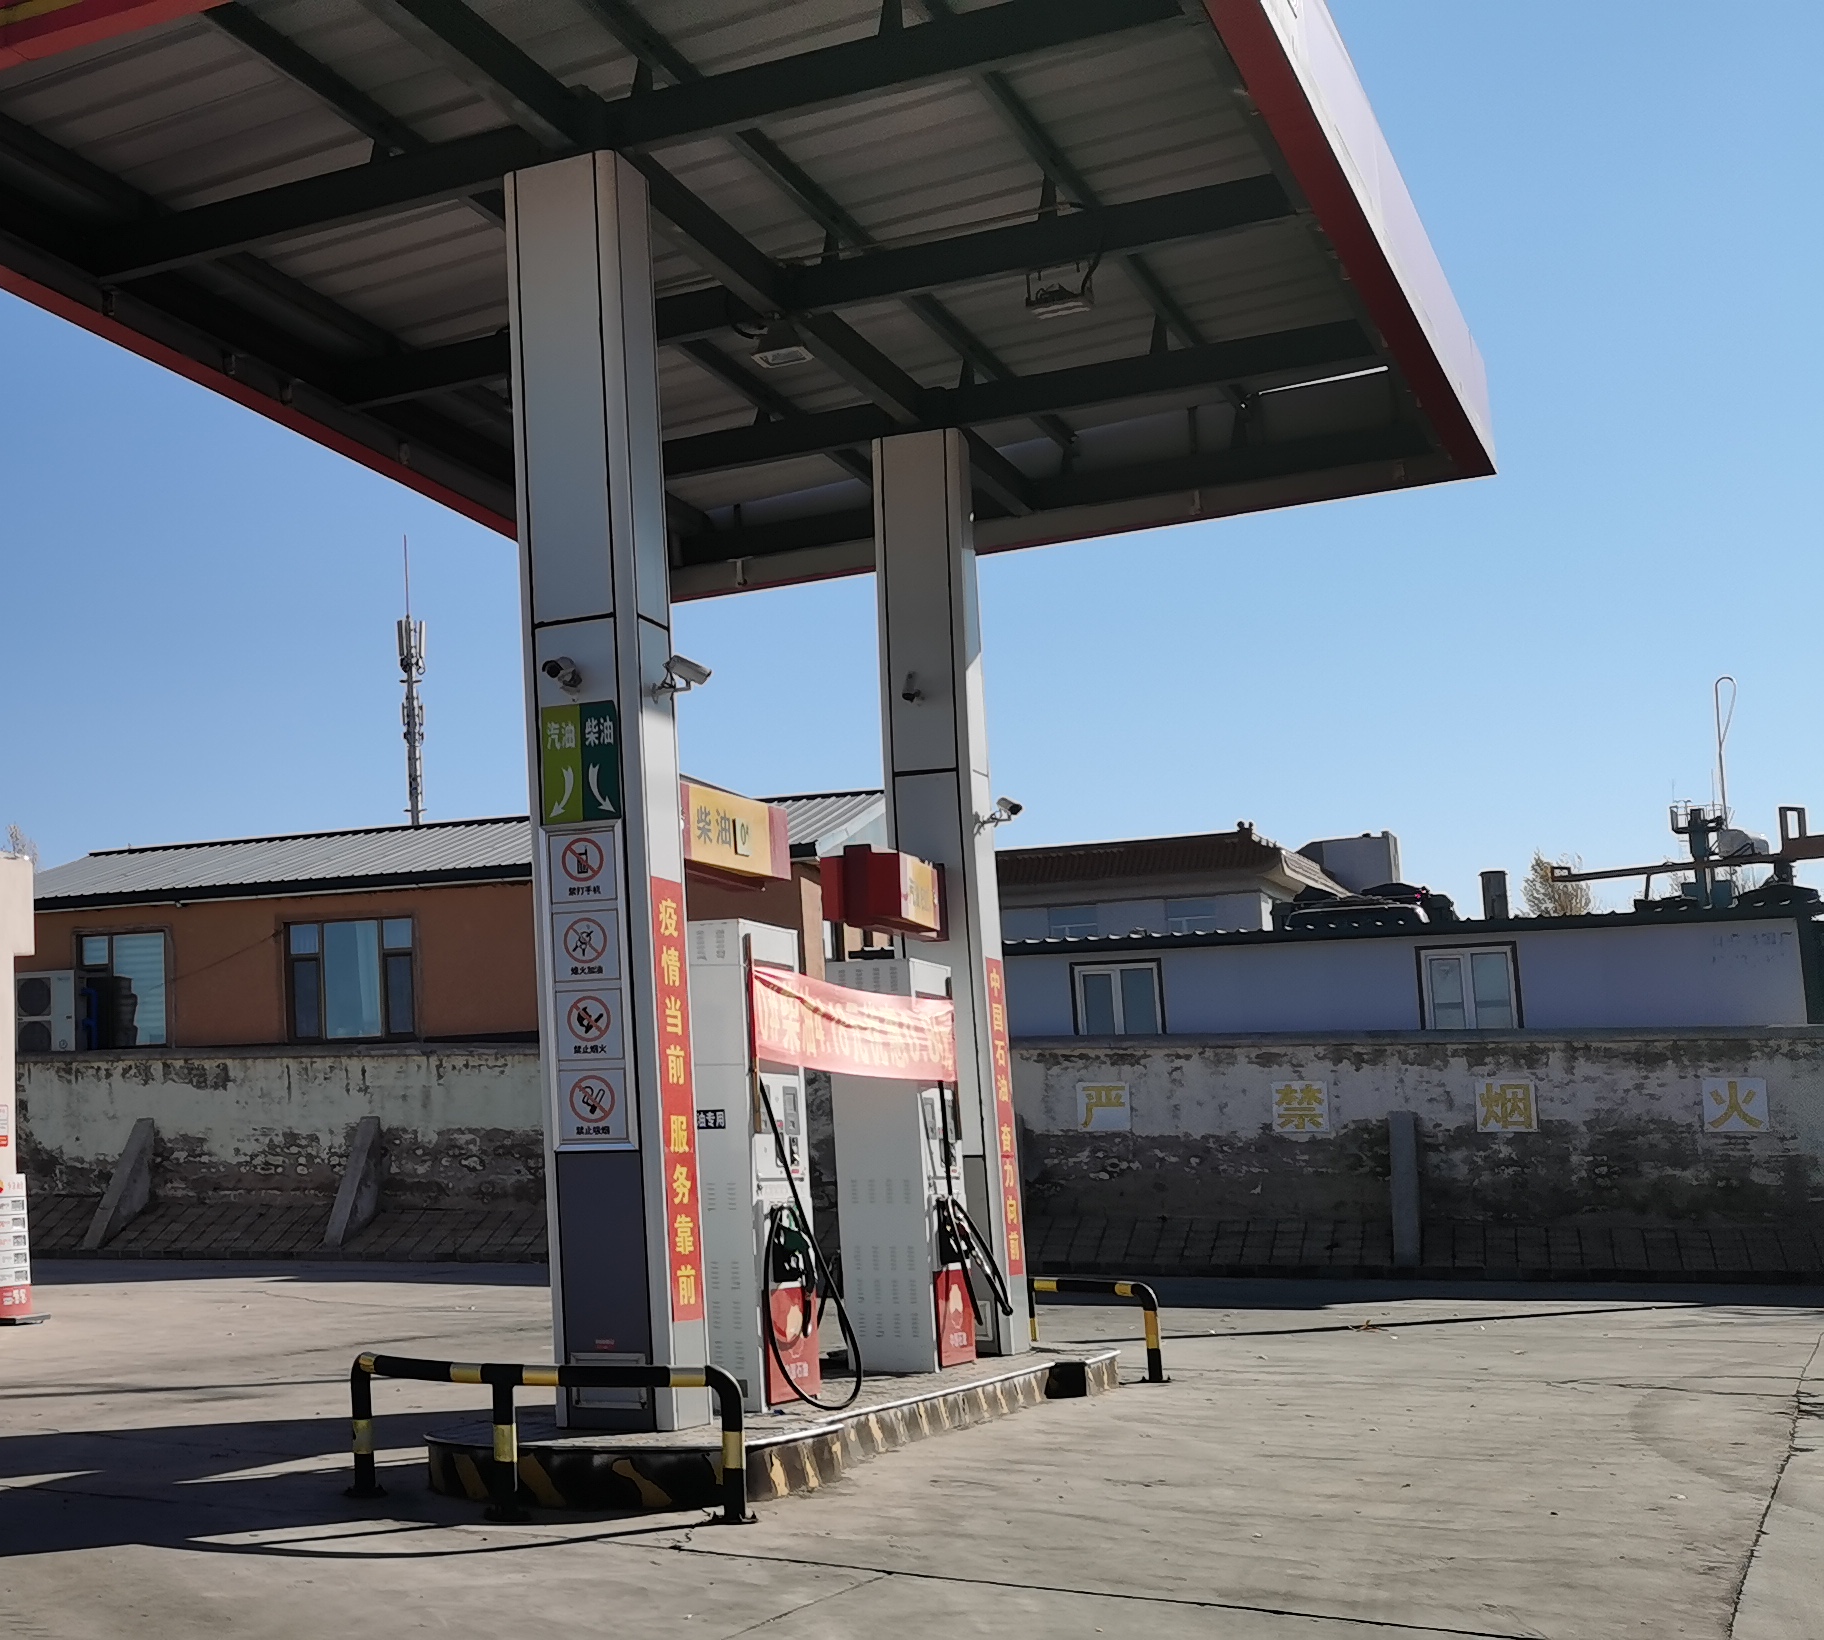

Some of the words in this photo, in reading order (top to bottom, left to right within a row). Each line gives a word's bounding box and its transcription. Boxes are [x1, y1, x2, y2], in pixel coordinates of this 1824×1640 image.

[546, 721, 576, 750] 汽油
[584, 715, 614, 747] 柴油
[696, 804, 732, 849] 柴油
[658, 898, 685, 1085] 疫情当前
[989, 967, 1010, 1103] 中国石油
[1081, 1084, 1127, 1129] 严
[1276, 1083, 1325, 1130] 禁
[1480, 1083, 1532, 1130] 烟
[1709, 1081, 1766, 1129] 火
[669, 1115, 696, 1306] 服务靠前
